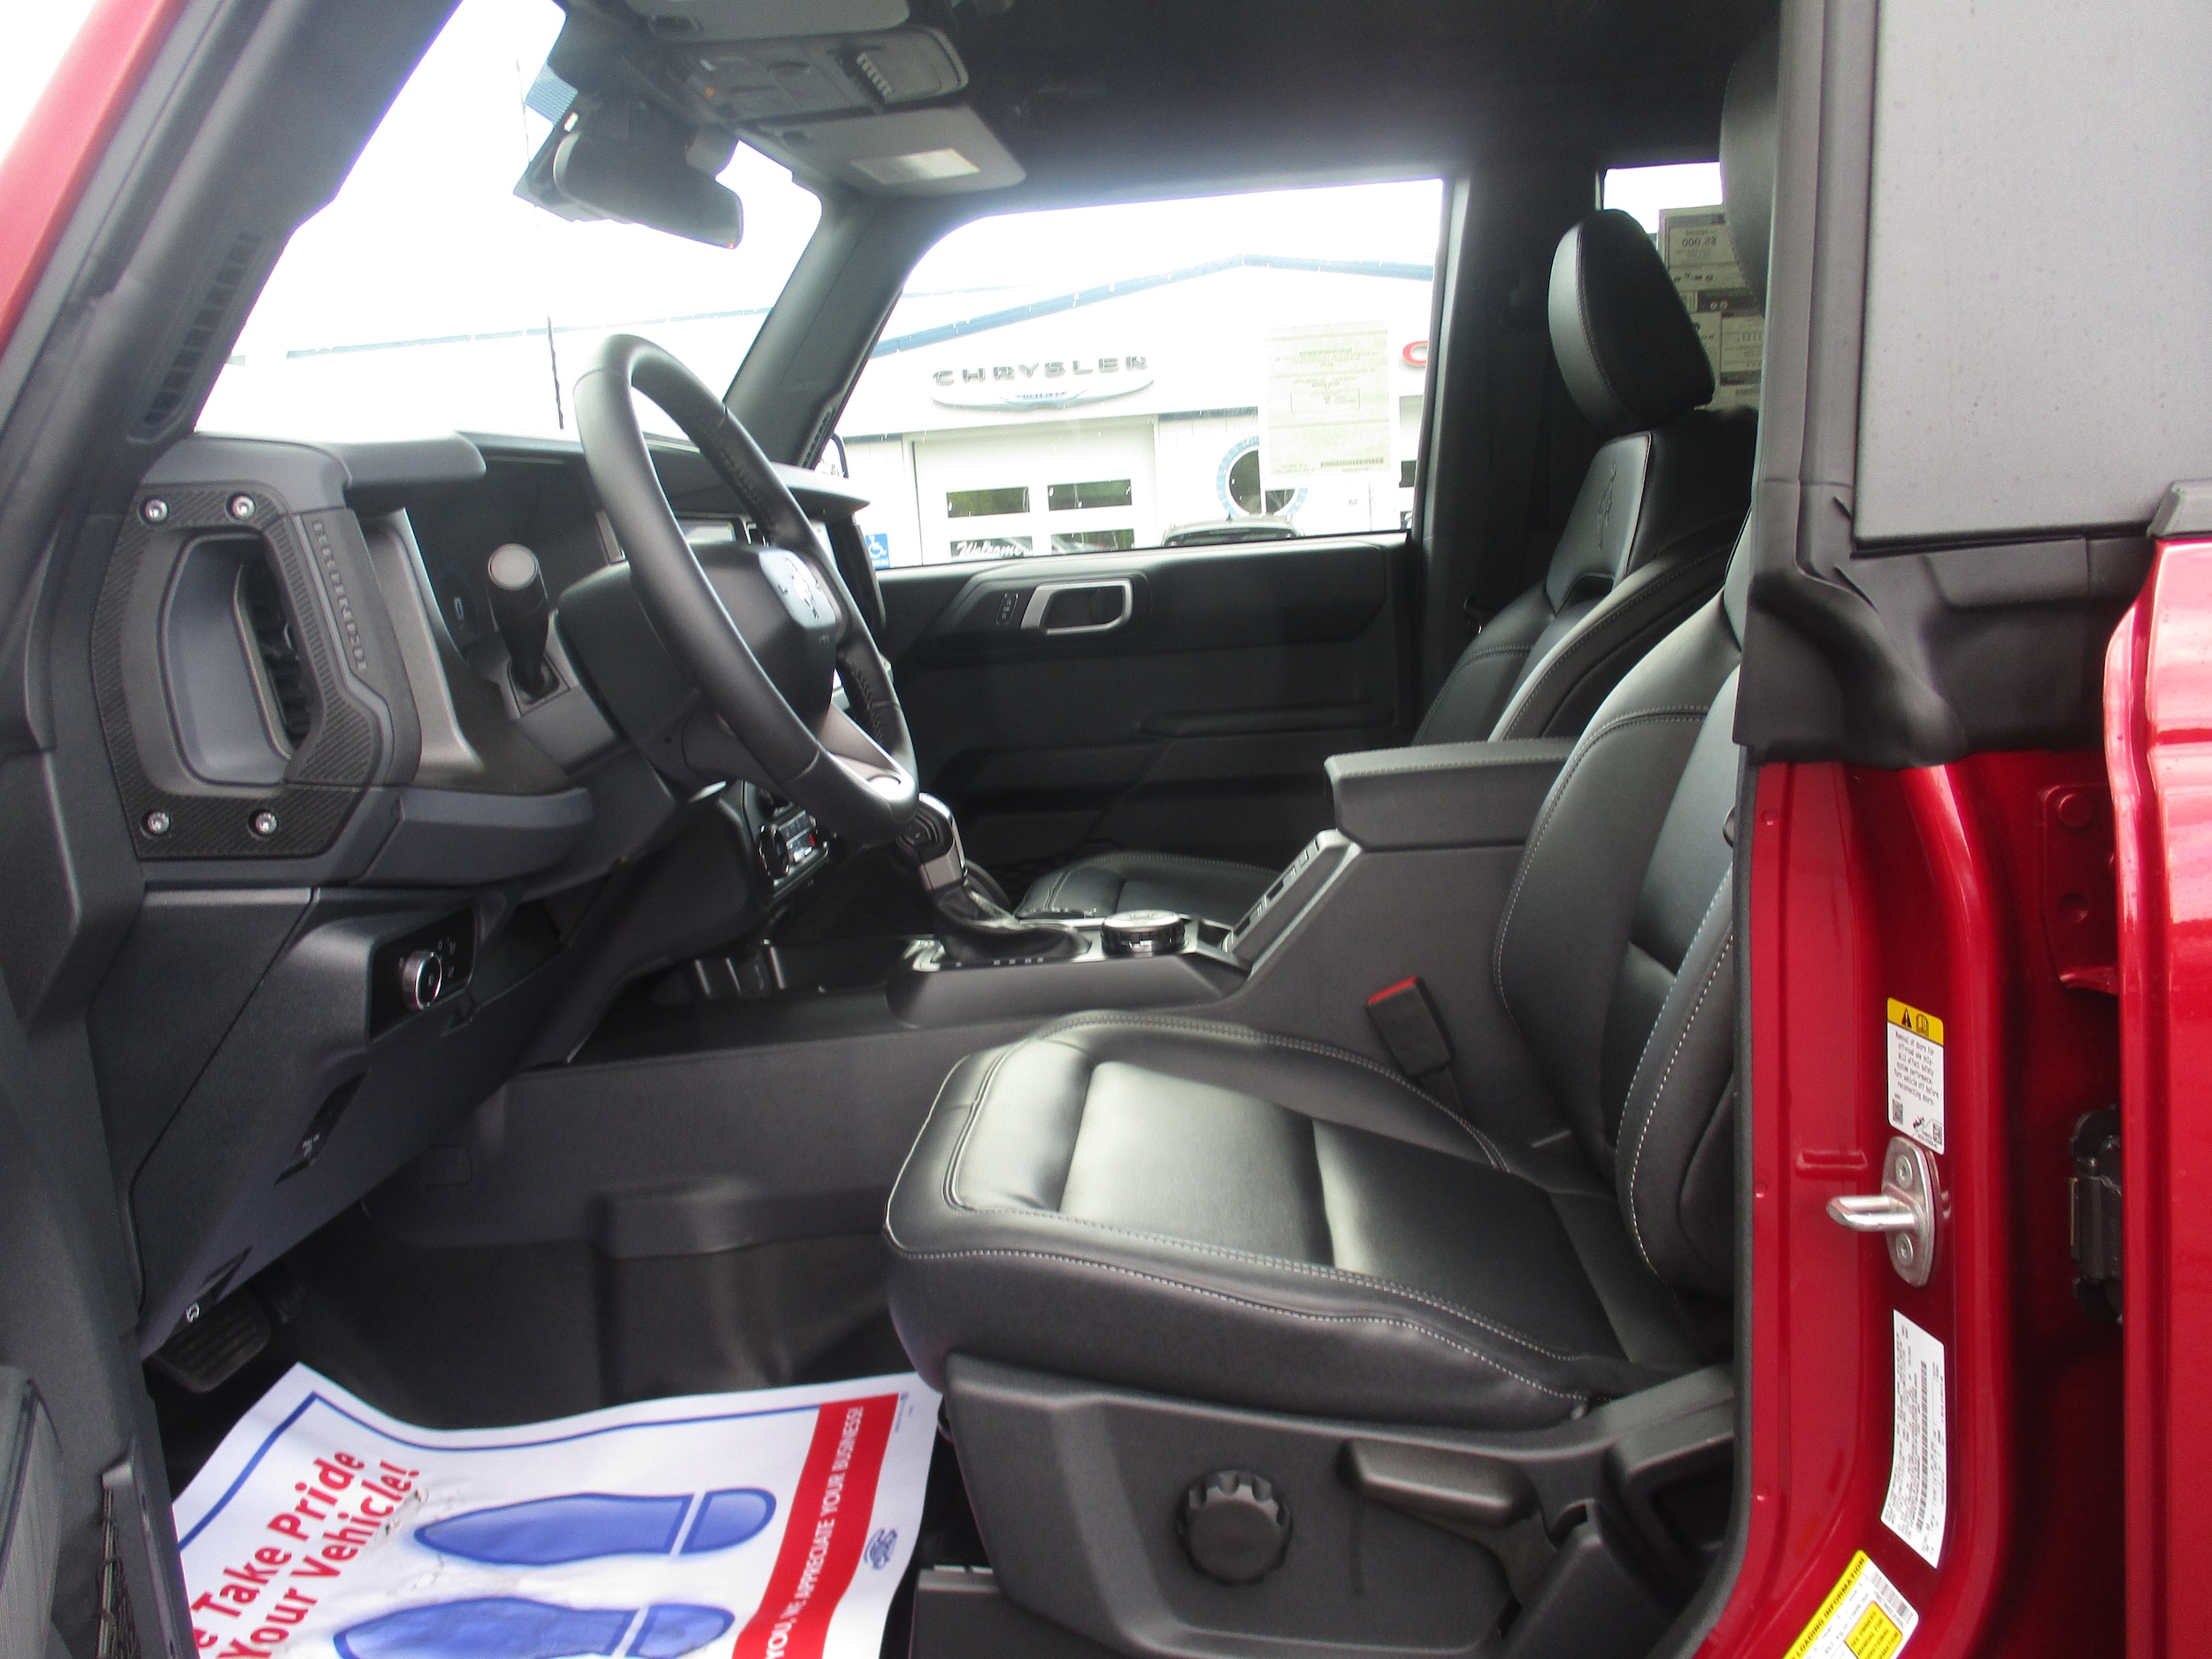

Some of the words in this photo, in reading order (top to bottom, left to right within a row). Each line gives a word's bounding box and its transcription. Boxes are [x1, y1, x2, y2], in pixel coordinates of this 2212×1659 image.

[933, 356, 1148, 385] CHRYSLER
[956, 541, 1023, 558] Welcome
[190, 1546, 292, 1617] Take
[267, 1451, 365, 1542] Pride
[216, 1586, 319, 1659] Your
[289, 1460, 419, 1578] Vehicle!
[795, 1517, 835, 1600] APPRECIATE
[820, 1471, 846, 1518] YOUR
[1796, 1618, 1824, 1658] LOADING
[1824, 1556, 1865, 1618] INFORMATION
